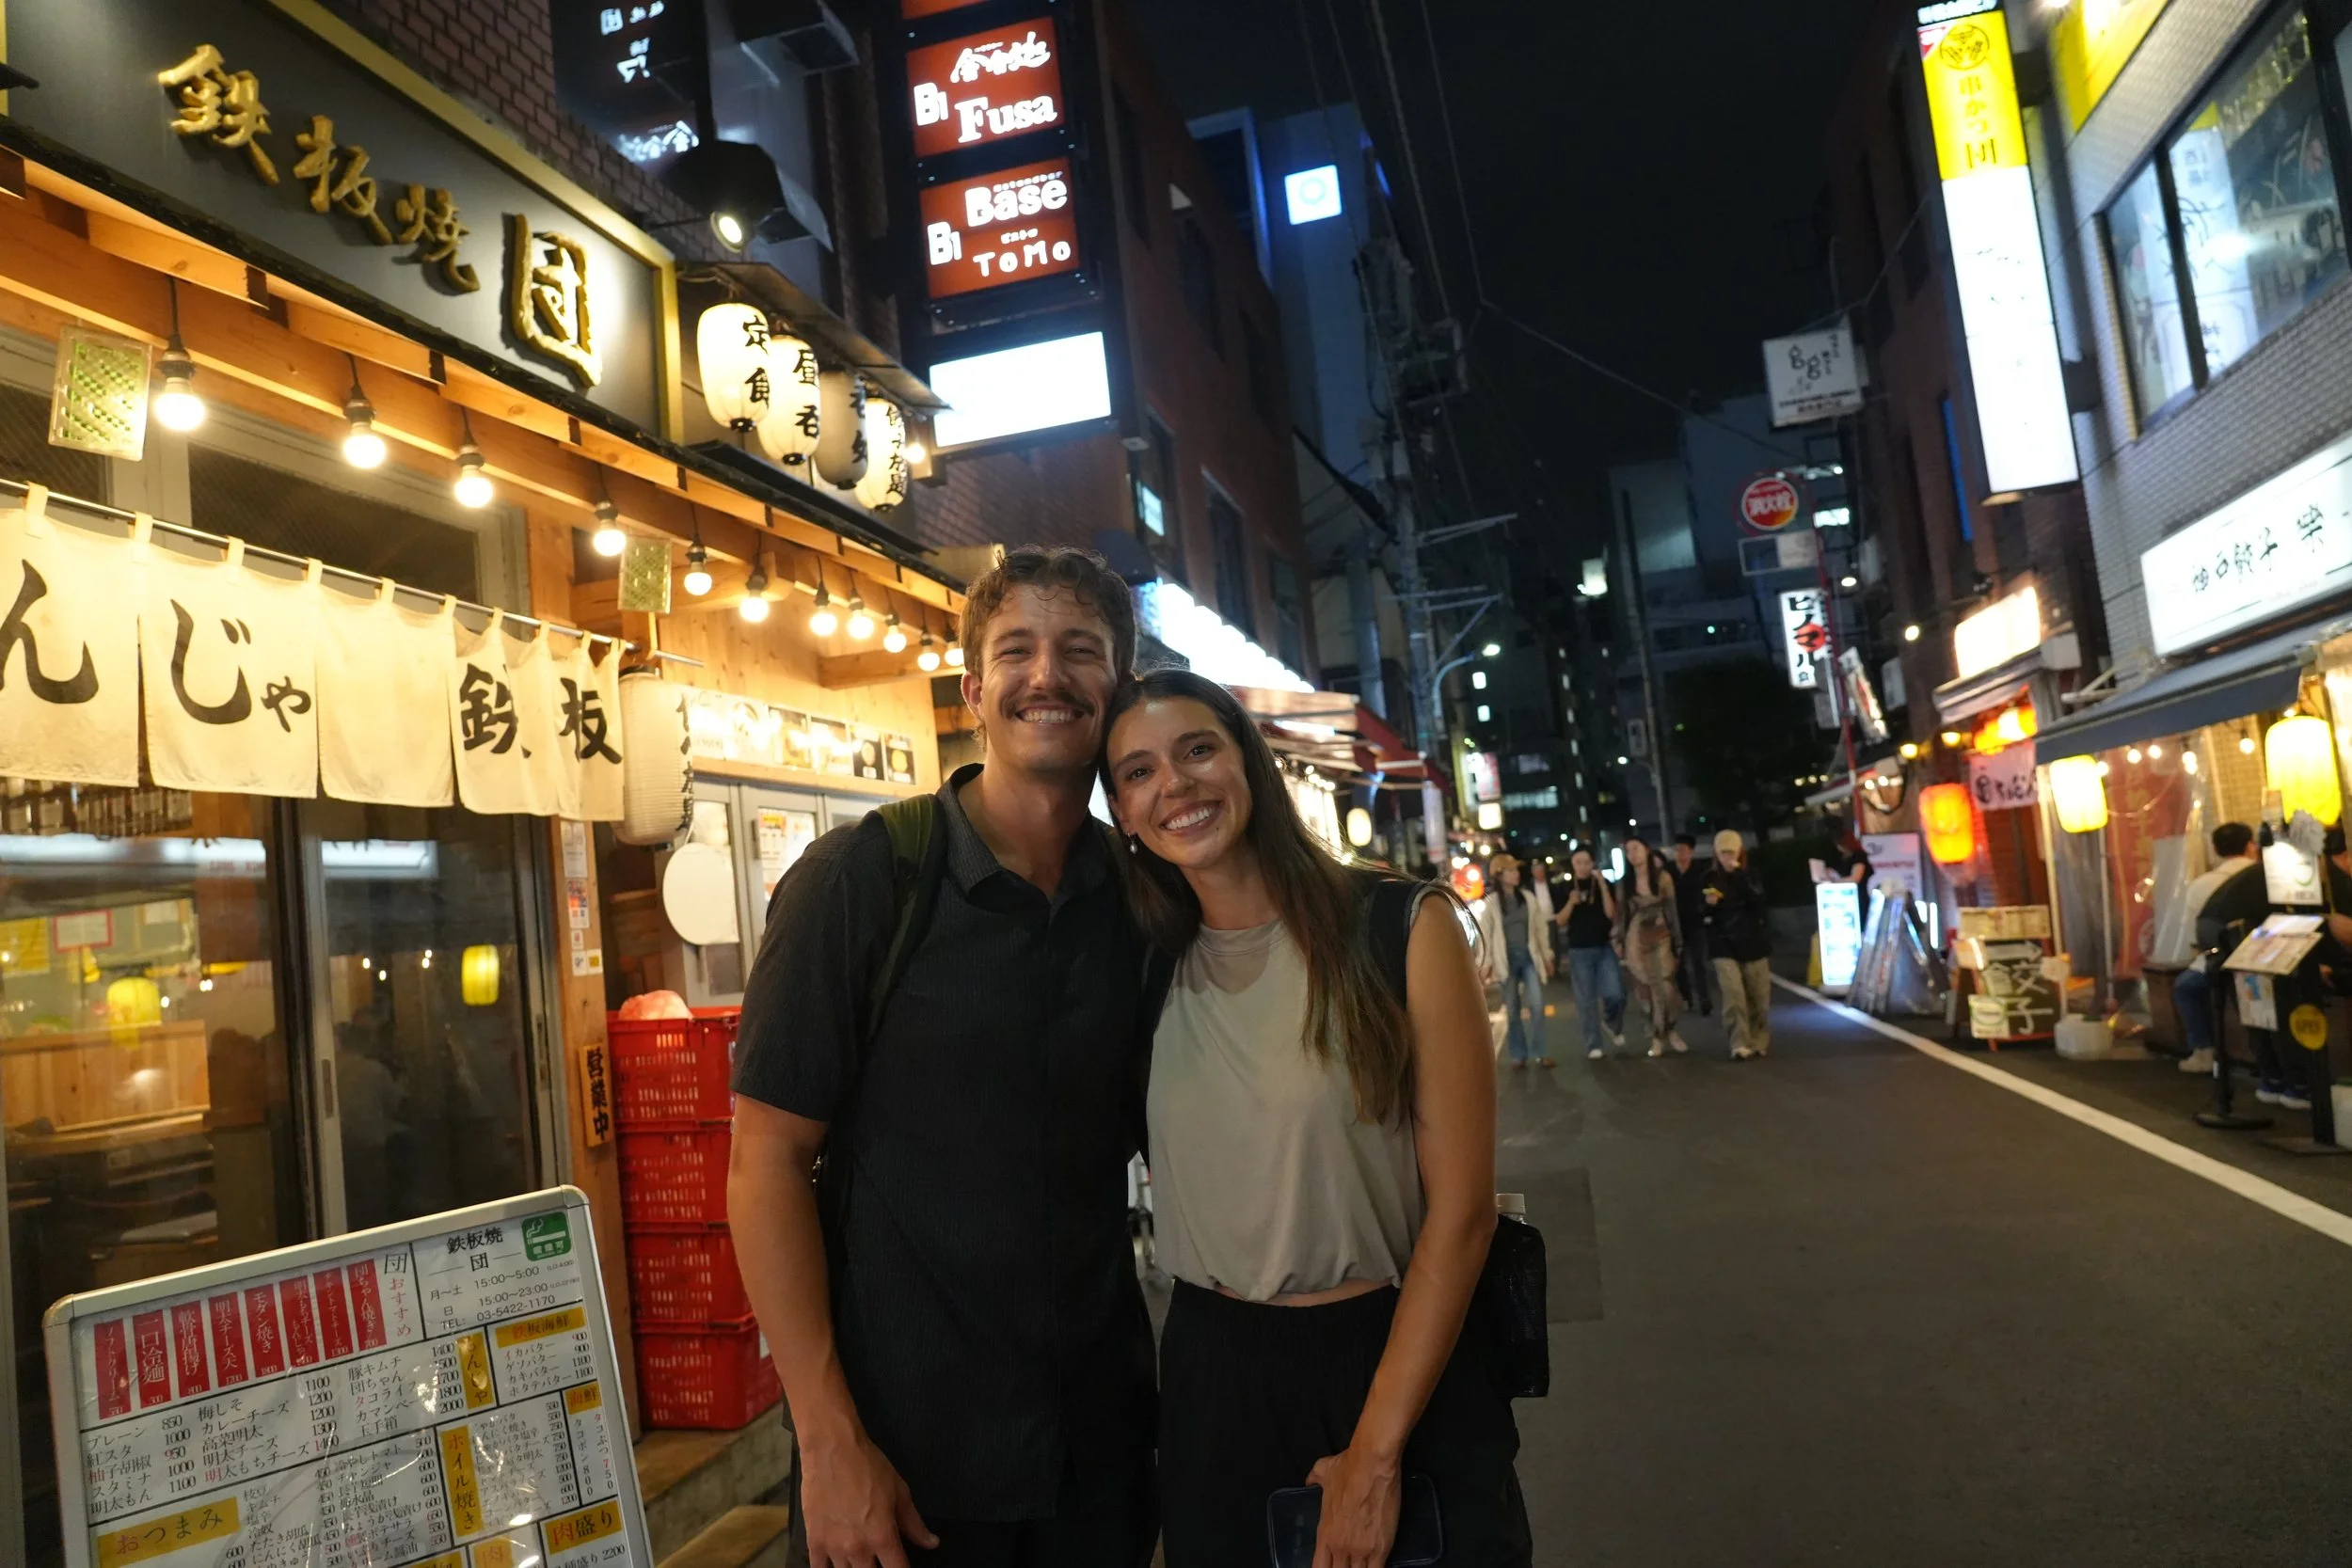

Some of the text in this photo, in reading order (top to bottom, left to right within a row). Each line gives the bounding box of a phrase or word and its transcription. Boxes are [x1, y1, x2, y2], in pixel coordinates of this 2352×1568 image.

[954, 95, 1057, 143] Fusa
[965, 180, 1068, 227] Base
[511, 213, 603, 388] 団
[742, 314, 770, 410] 定食
[459, 661, 624, 766] 鉄板
[586, 1045, 610, 1141] 営業中
[447, 1227, 503, 1254] 鉄板焼
[470, 1252, 489, 1272] 団
[384, 1253, 411, 1338] 団 おすすめ
[440, 1294, 556, 1331] TEL: 03-5422-1170
[443, 1306, 453, 1317] 日
[254, 1291, 275, 1354] モダン焼き
[348, 1342, 454, 1381] 豚キムチ 1400
[505, 1343, 556, 1361] イカバター
[199, 1376, 330, 1422] 梅しそ 1100
[350, 1370, 405, 1396] 団ちゃん
[438, 1385, 462, 1400] 1800
[202, 1390, 333, 1436] カレーチーズ 1200
[439, 1399, 464, 1415] 2000
[88, 1414, 183, 1451] プレーン 850
[165, 1429, 191, 1446] 1000
[202, 1405, 335, 1453] 高菜明太 1200
[203, 1420, 337, 1467] 明太チーズ 1300
[165, 1446, 186, 1461] 950
[205, 1441, 310, 1482] 明太もちチーズ
[419, 1461, 435, 1472] 600
[94, 1459, 195, 1497] スタミナ 1000
[169, 1476, 197, 1494] 1100
[421, 1472, 437, 1484] 600
[422, 1484, 438, 1497] 600
[449, 1434, 475, 1529] ホイル焼き
[117, 1509, 223, 1555] おつまみ
[552, 1510, 612, 1545] 肉盛り
[226, 1545, 245, 1559] 600
[602, 1544, 625, 1561] 2200
